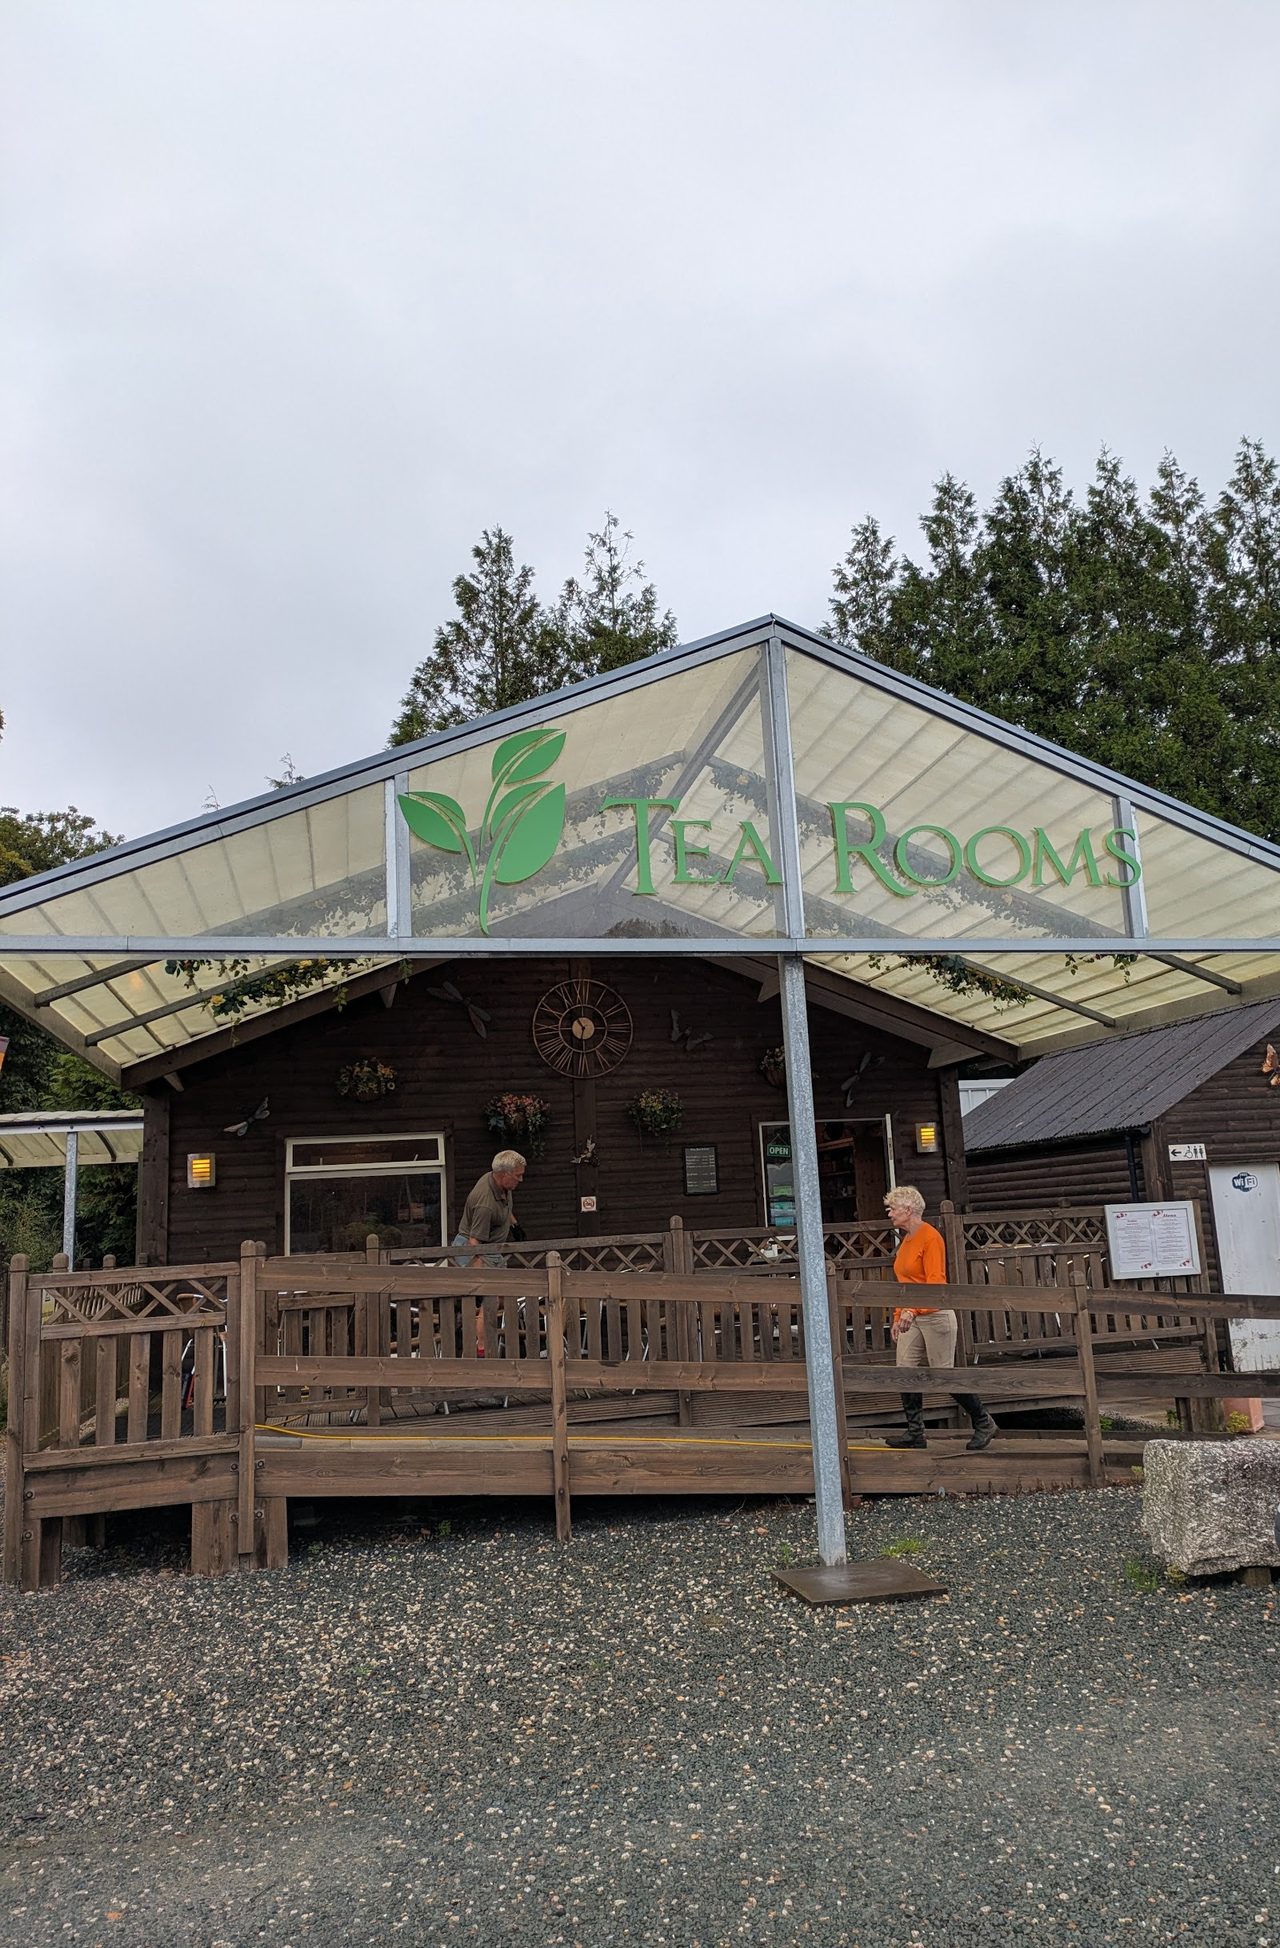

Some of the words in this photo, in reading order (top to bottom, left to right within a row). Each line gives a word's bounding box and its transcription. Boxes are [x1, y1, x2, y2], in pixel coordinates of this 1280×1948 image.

[601, 798, 784, 896] TEA
[826, 801, 1142, 897] ROOMS
[769, 1147, 789, 1155] OPEN
